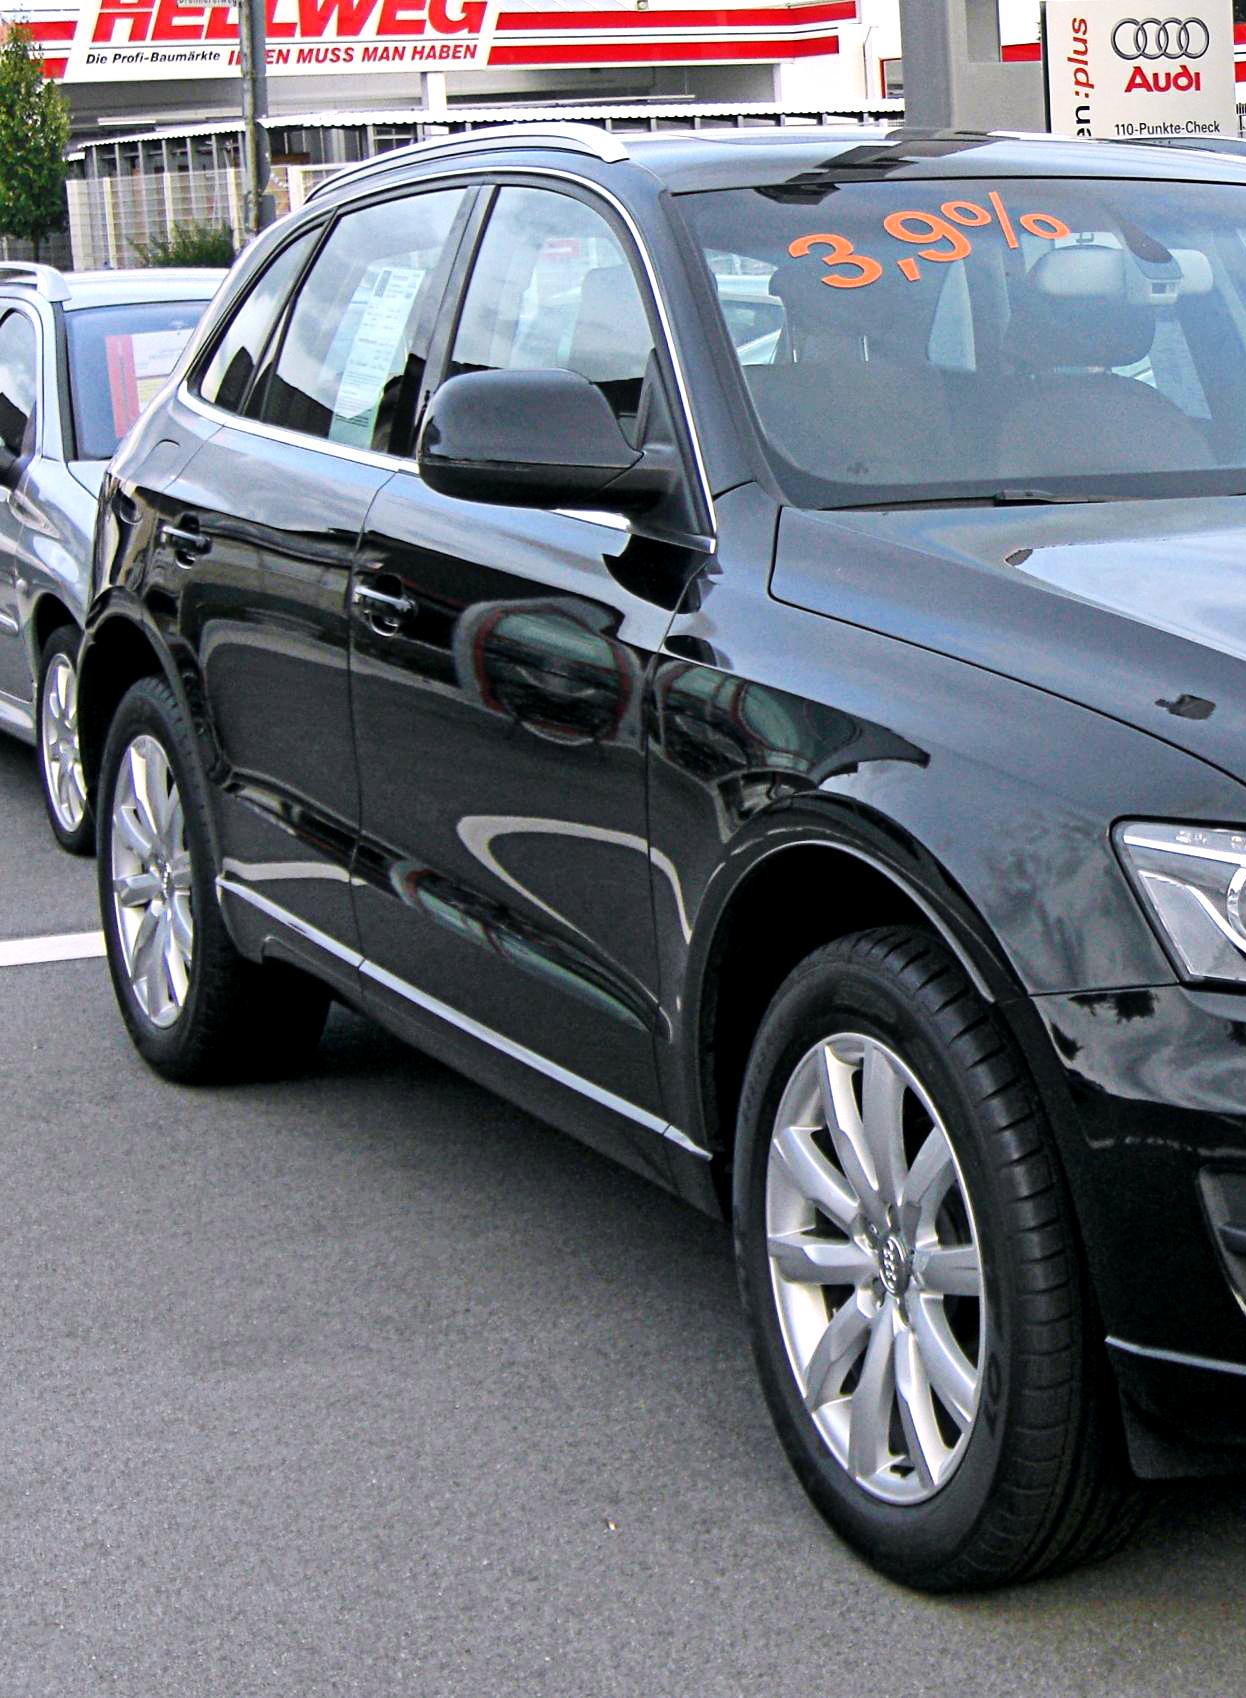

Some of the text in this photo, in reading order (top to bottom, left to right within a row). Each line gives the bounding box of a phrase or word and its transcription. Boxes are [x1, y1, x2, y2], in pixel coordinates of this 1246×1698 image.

[86, 50, 221, 65] Die Profi-Baumärkte
[296, 47, 354, 64] MUSS
[361, 45, 406, 62] MAN
[411, 44, 478, 61] HABEN
[1124, 65, 1201, 93] Audi
[1115, 120, 1220, 136] 110-Punkte-Check
